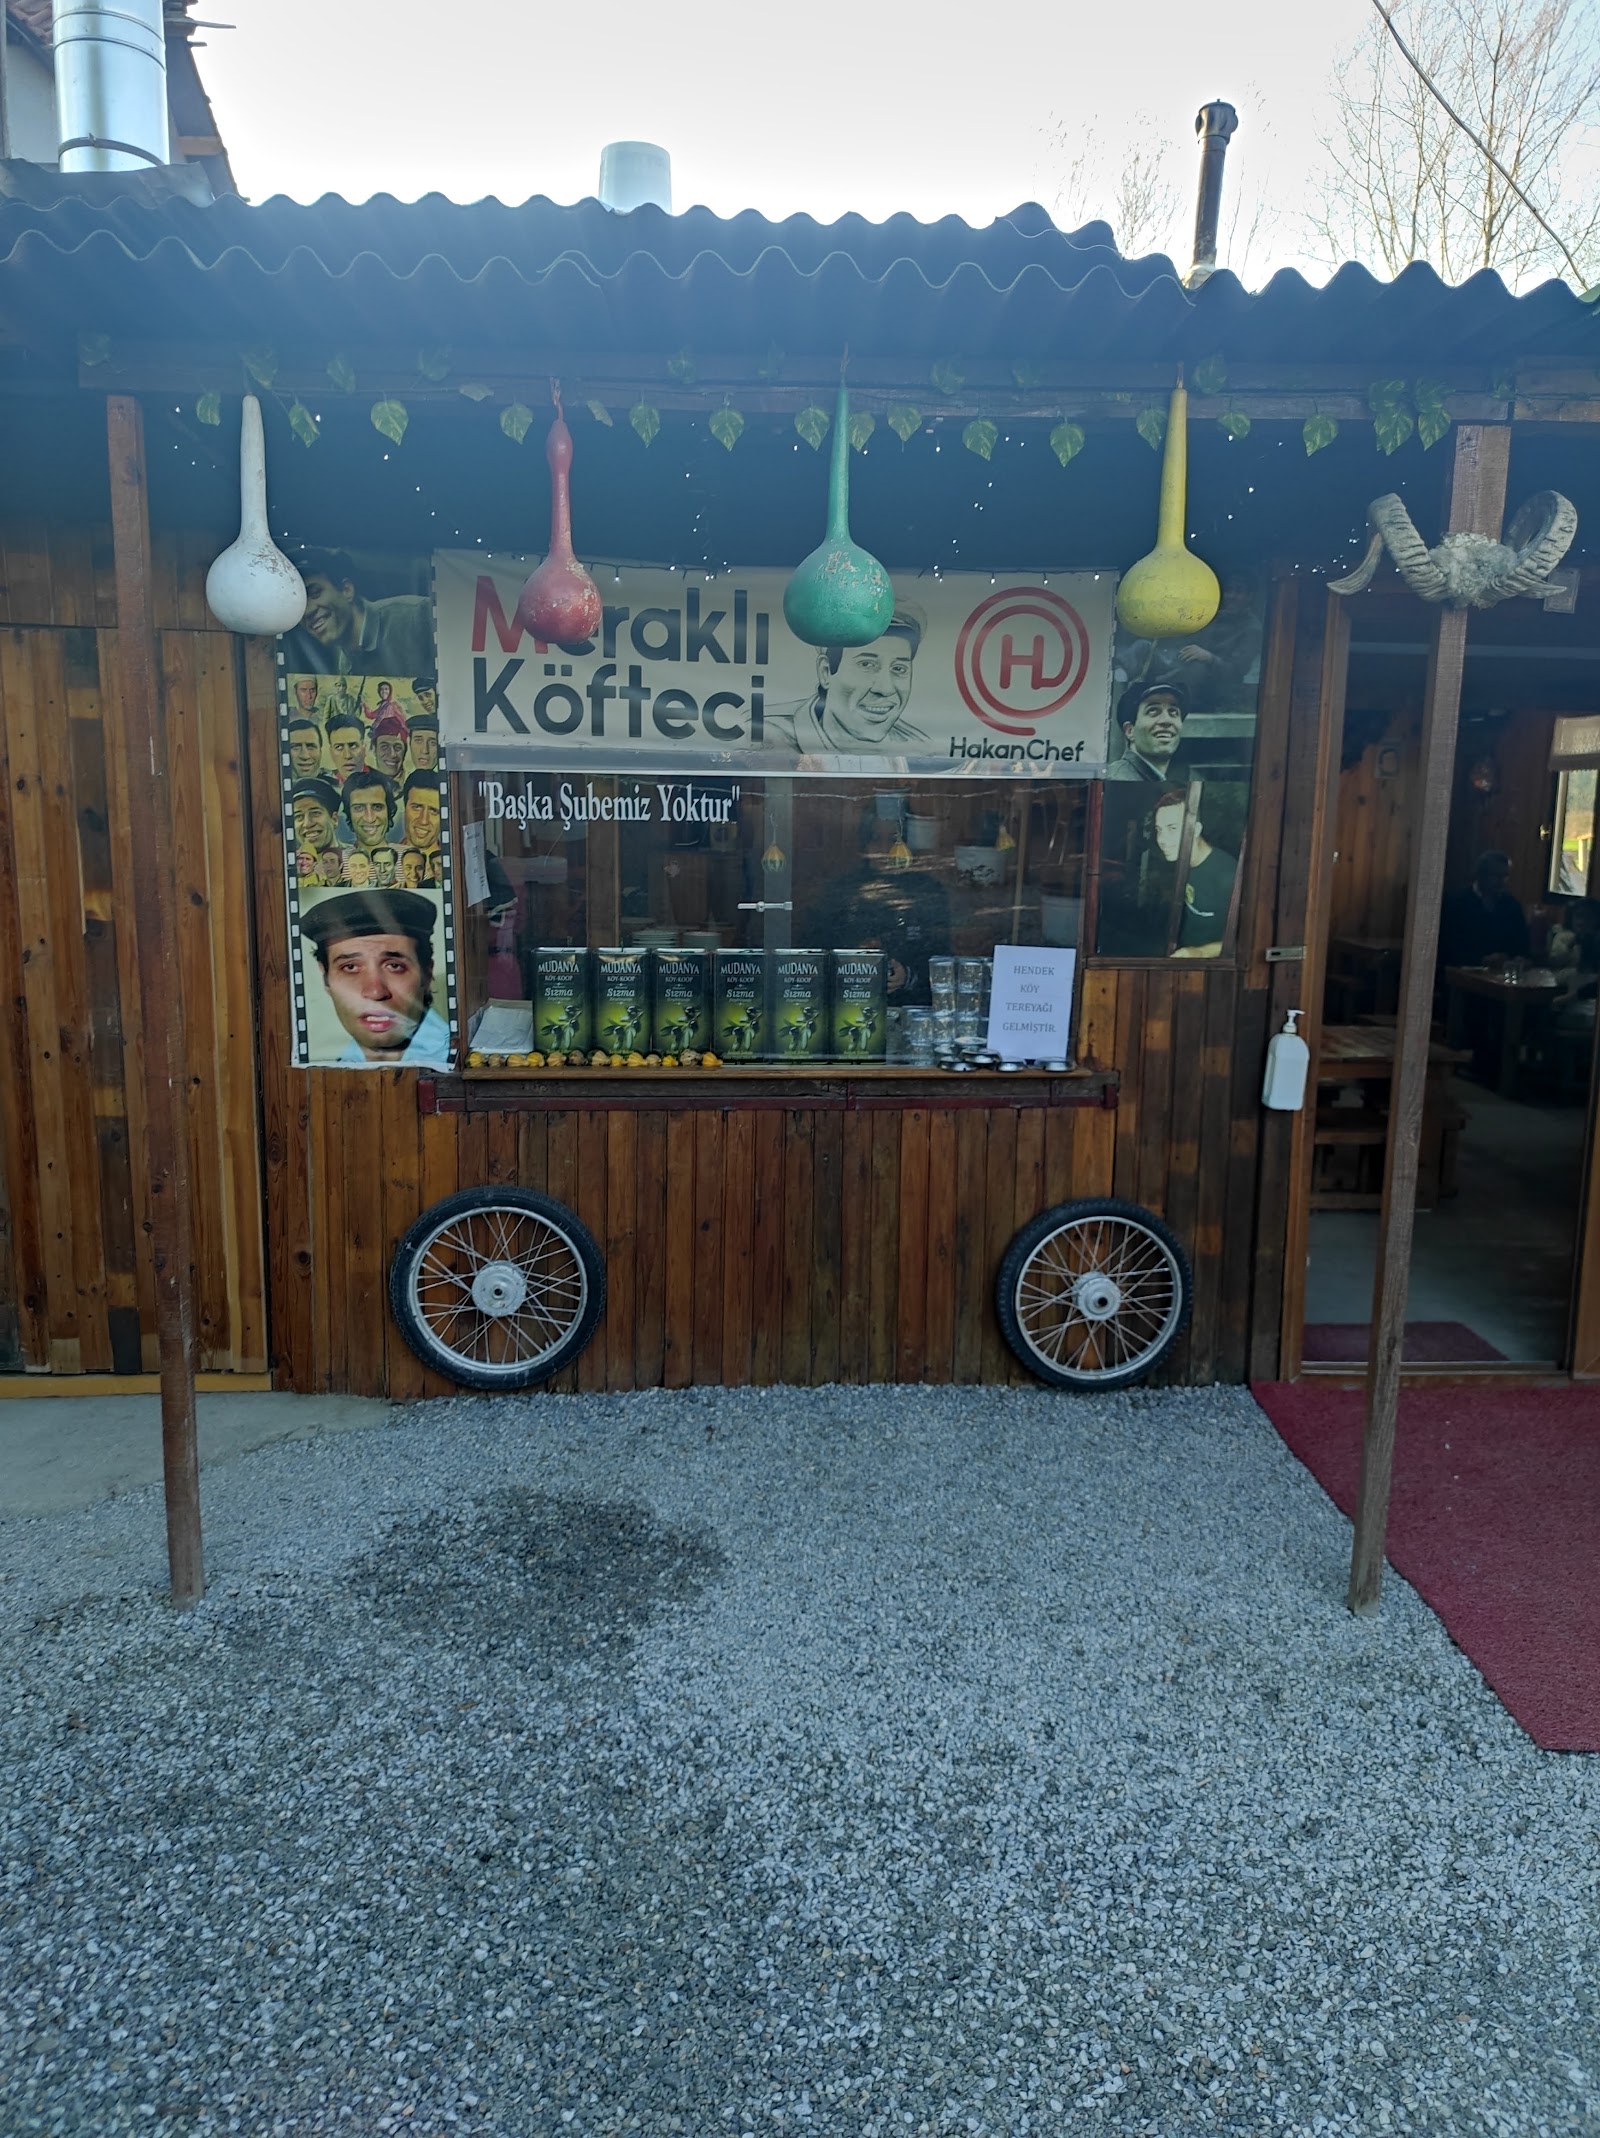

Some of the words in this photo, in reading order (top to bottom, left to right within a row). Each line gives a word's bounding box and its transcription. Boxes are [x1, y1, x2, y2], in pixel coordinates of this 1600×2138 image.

[472, 575, 769, 665] Mraklı
[473, 657, 764, 742] Köfteci
[949, 736, 1085, 762] HakanChef
[478, 780, 555, 830] "Başka
[560, 782, 652, 831] Şubemiz
[656, 783, 741, 824] Yoktur"
[538, 960, 580, 973] MUDANYA
[600, 961, 642, 974] MUDANYA
[658, 962, 700, 975] MUDANYA
[720, 962, 761, 975] MUDANYA
[777, 962, 818, 975] MUDANYA
[837, 962, 878, 975] MUDANYA
